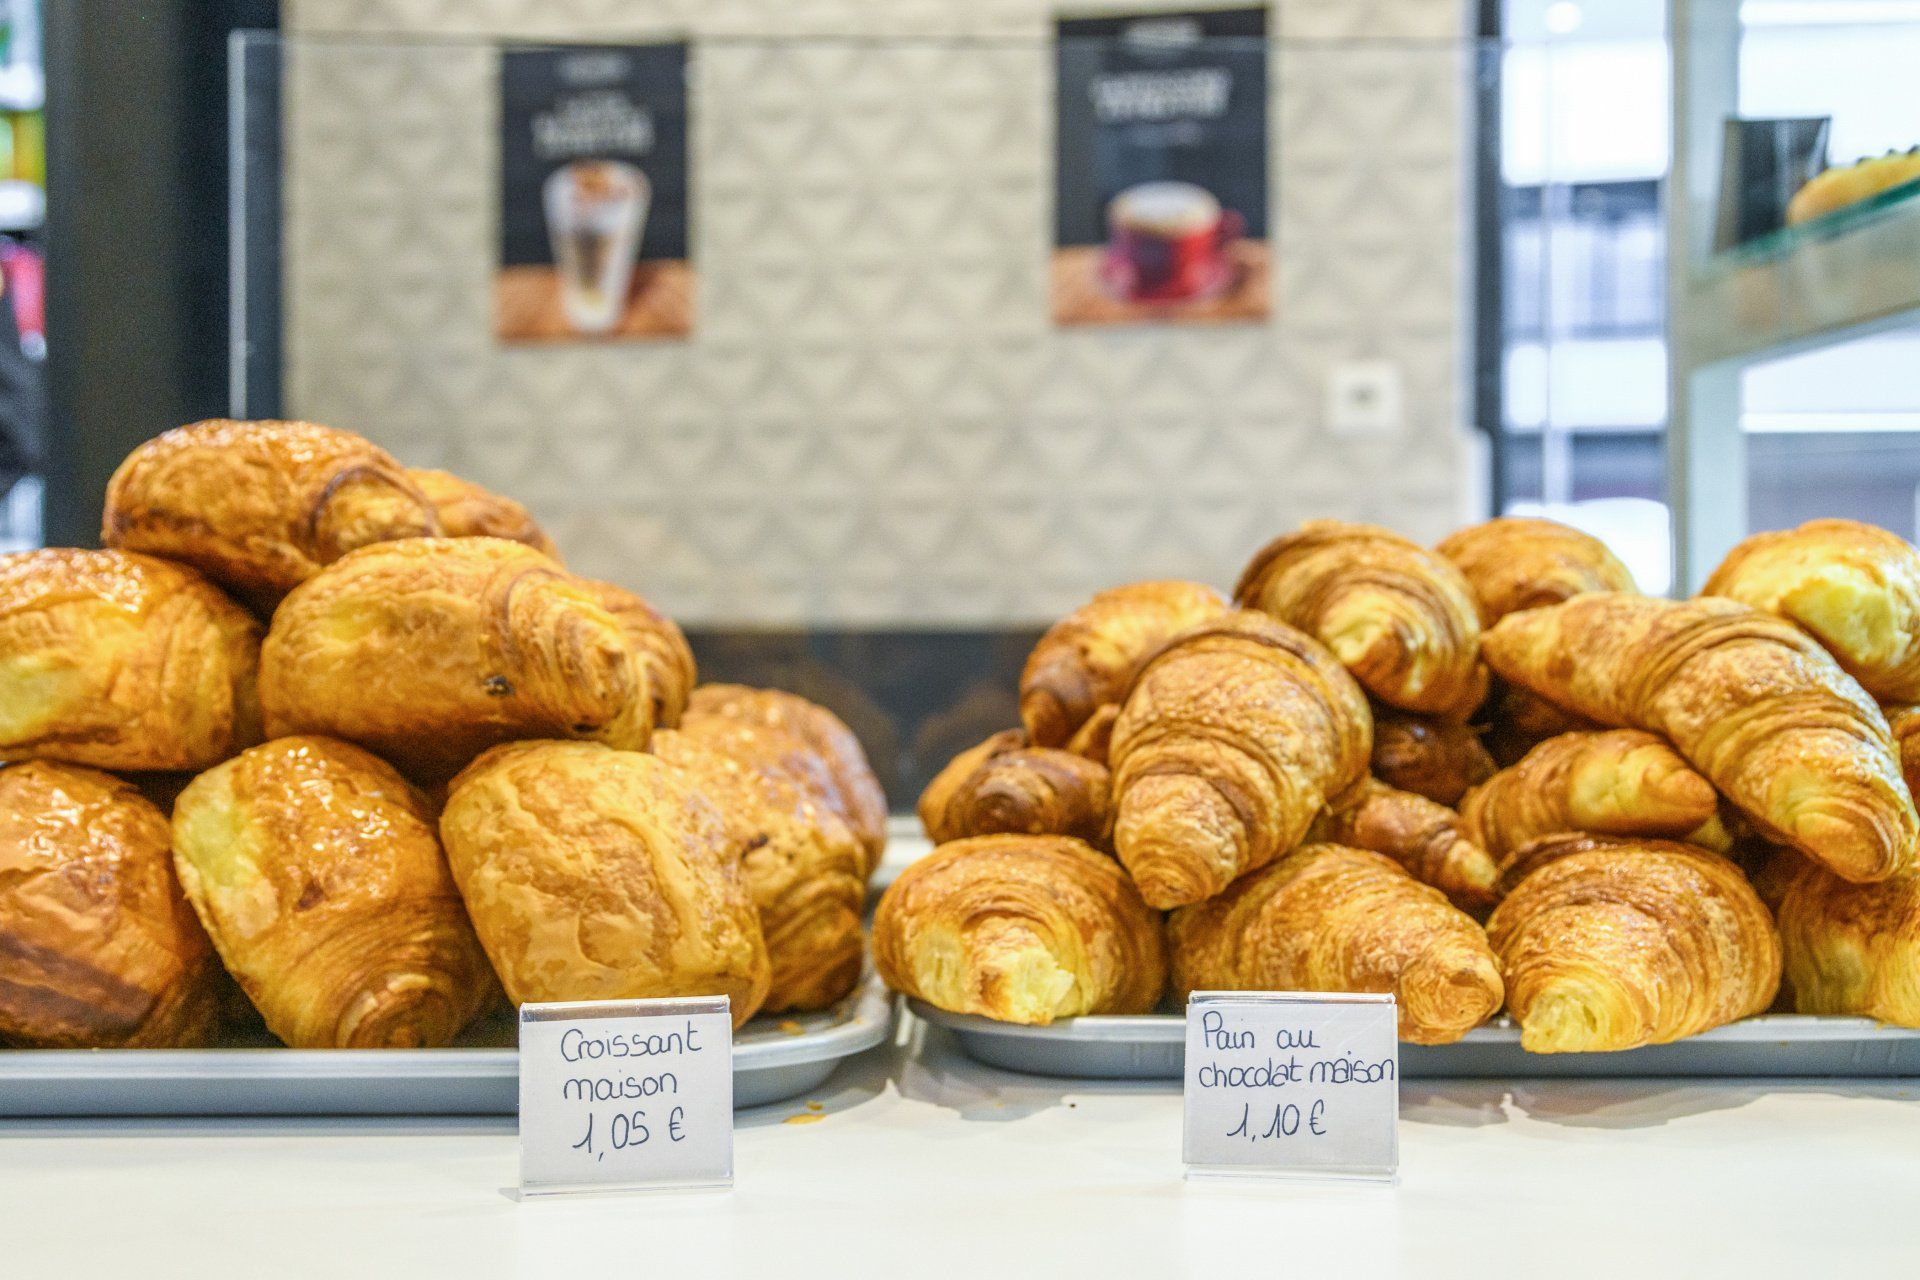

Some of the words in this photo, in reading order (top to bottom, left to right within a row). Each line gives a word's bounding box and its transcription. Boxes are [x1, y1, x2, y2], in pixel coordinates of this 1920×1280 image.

[561, 1020, 702, 1062] Croissant
[1203, 1010, 1255, 1050] Pain
[1276, 1029, 1321, 1049] au
[563, 1068, 678, 1102] maison
[1309, 1050, 1395, 1084] maison
[572, 1110, 650, 1162] 1,05
[669, 1106, 686, 1142] €
[1226, 1102, 1300, 1142] 1,10
[1309, 1099, 1327, 1136] €
